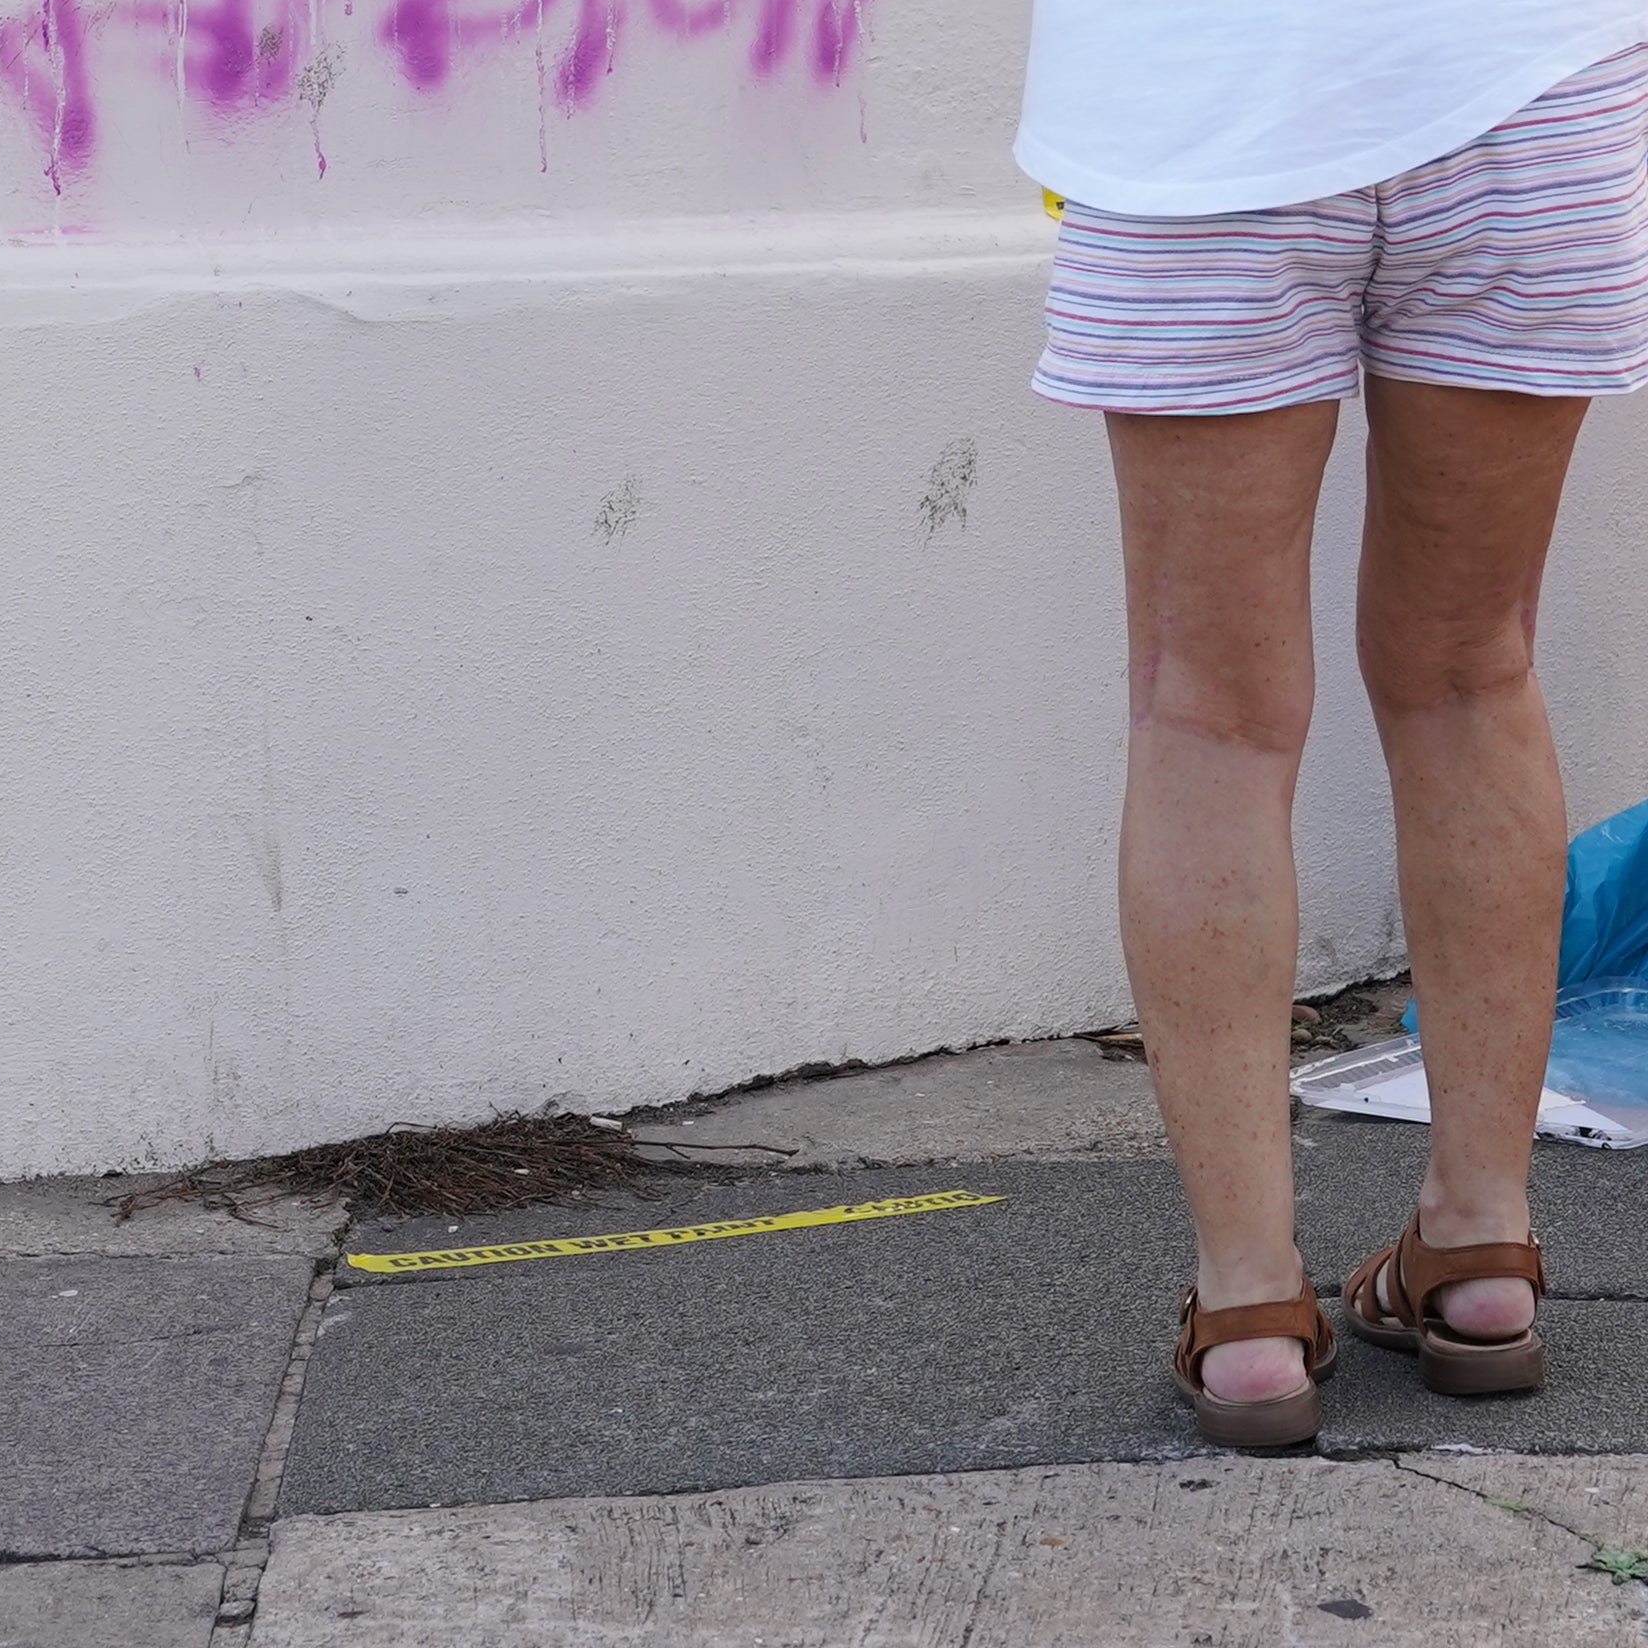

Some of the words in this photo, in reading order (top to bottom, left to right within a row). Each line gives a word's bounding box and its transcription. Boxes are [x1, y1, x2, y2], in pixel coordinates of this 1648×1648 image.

[389, 1242, 564, 1269] CAUTION
[566, 1233, 652, 1249] WET
[663, 1218, 776, 1240] PAINT
